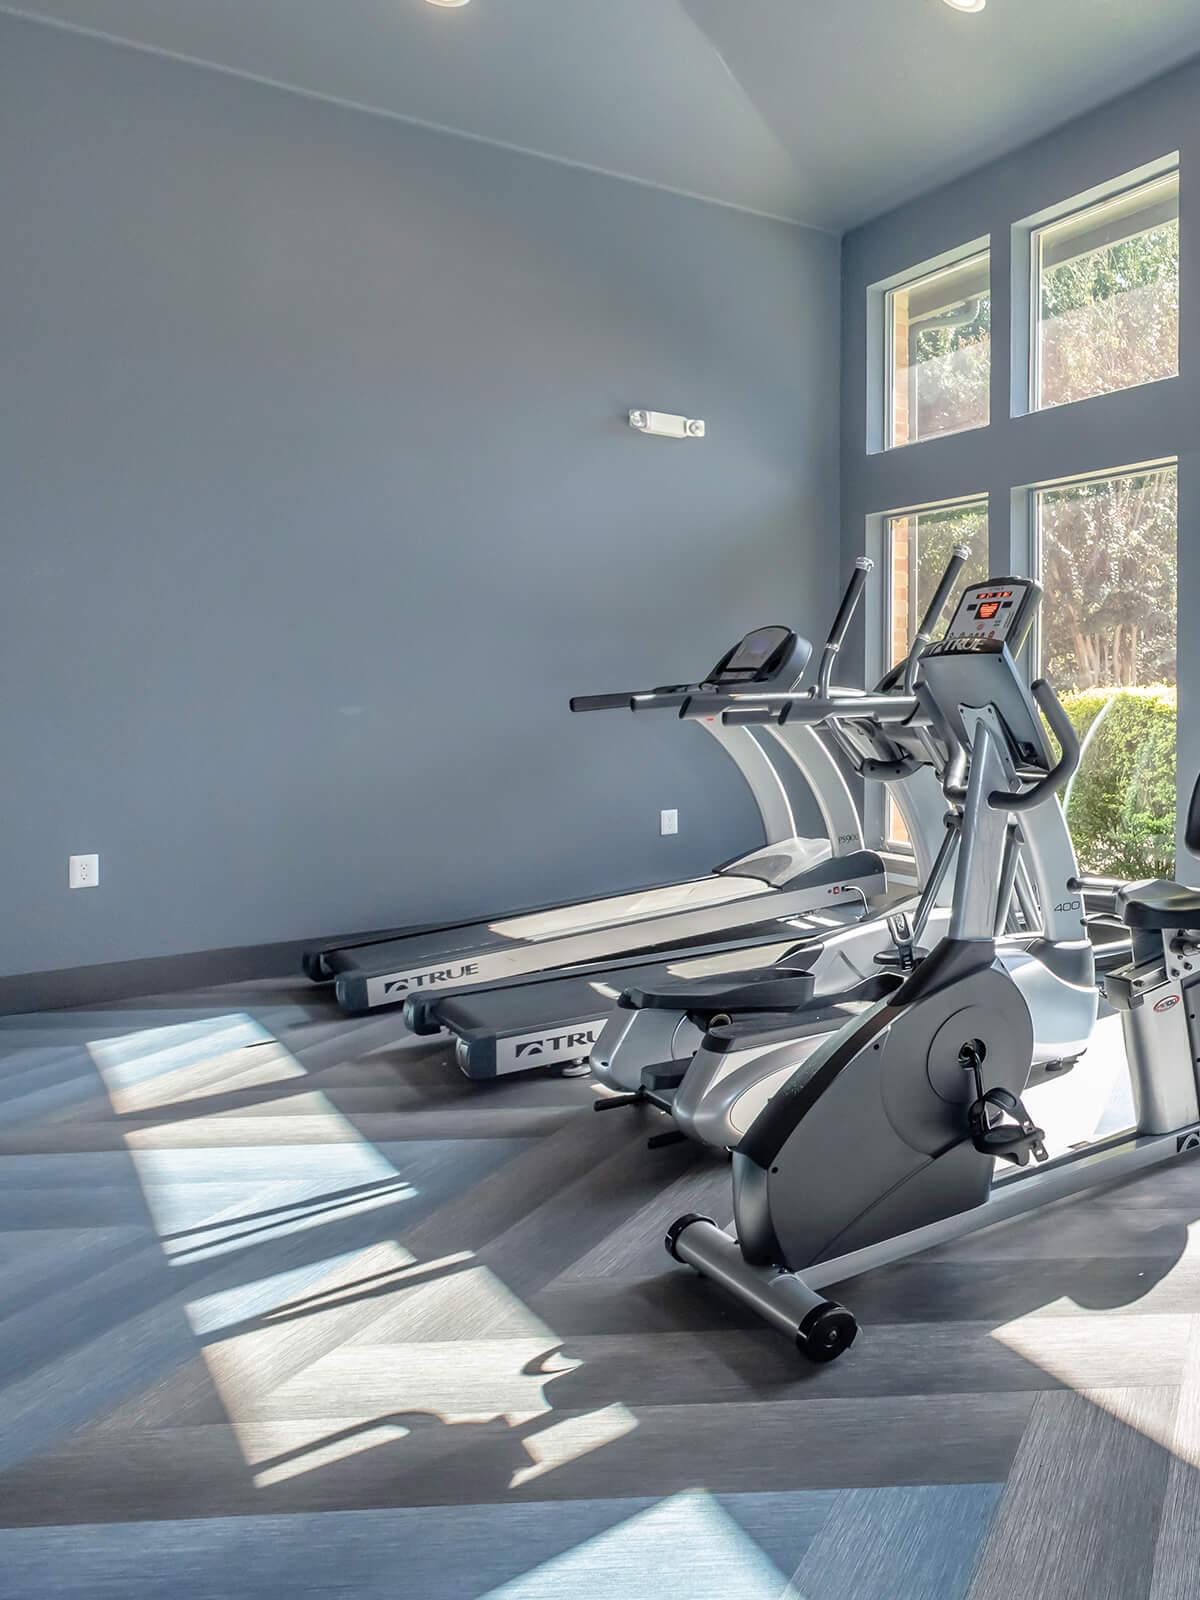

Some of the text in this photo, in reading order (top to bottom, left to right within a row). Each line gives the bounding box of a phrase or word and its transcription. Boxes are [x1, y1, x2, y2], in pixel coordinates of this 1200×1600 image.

[943, 638, 984, 652] TRUE
[1054, 901, 1080, 912] 400
[410, 963, 479, 987] TRUE
[546, 1031, 596, 1050] TRU
